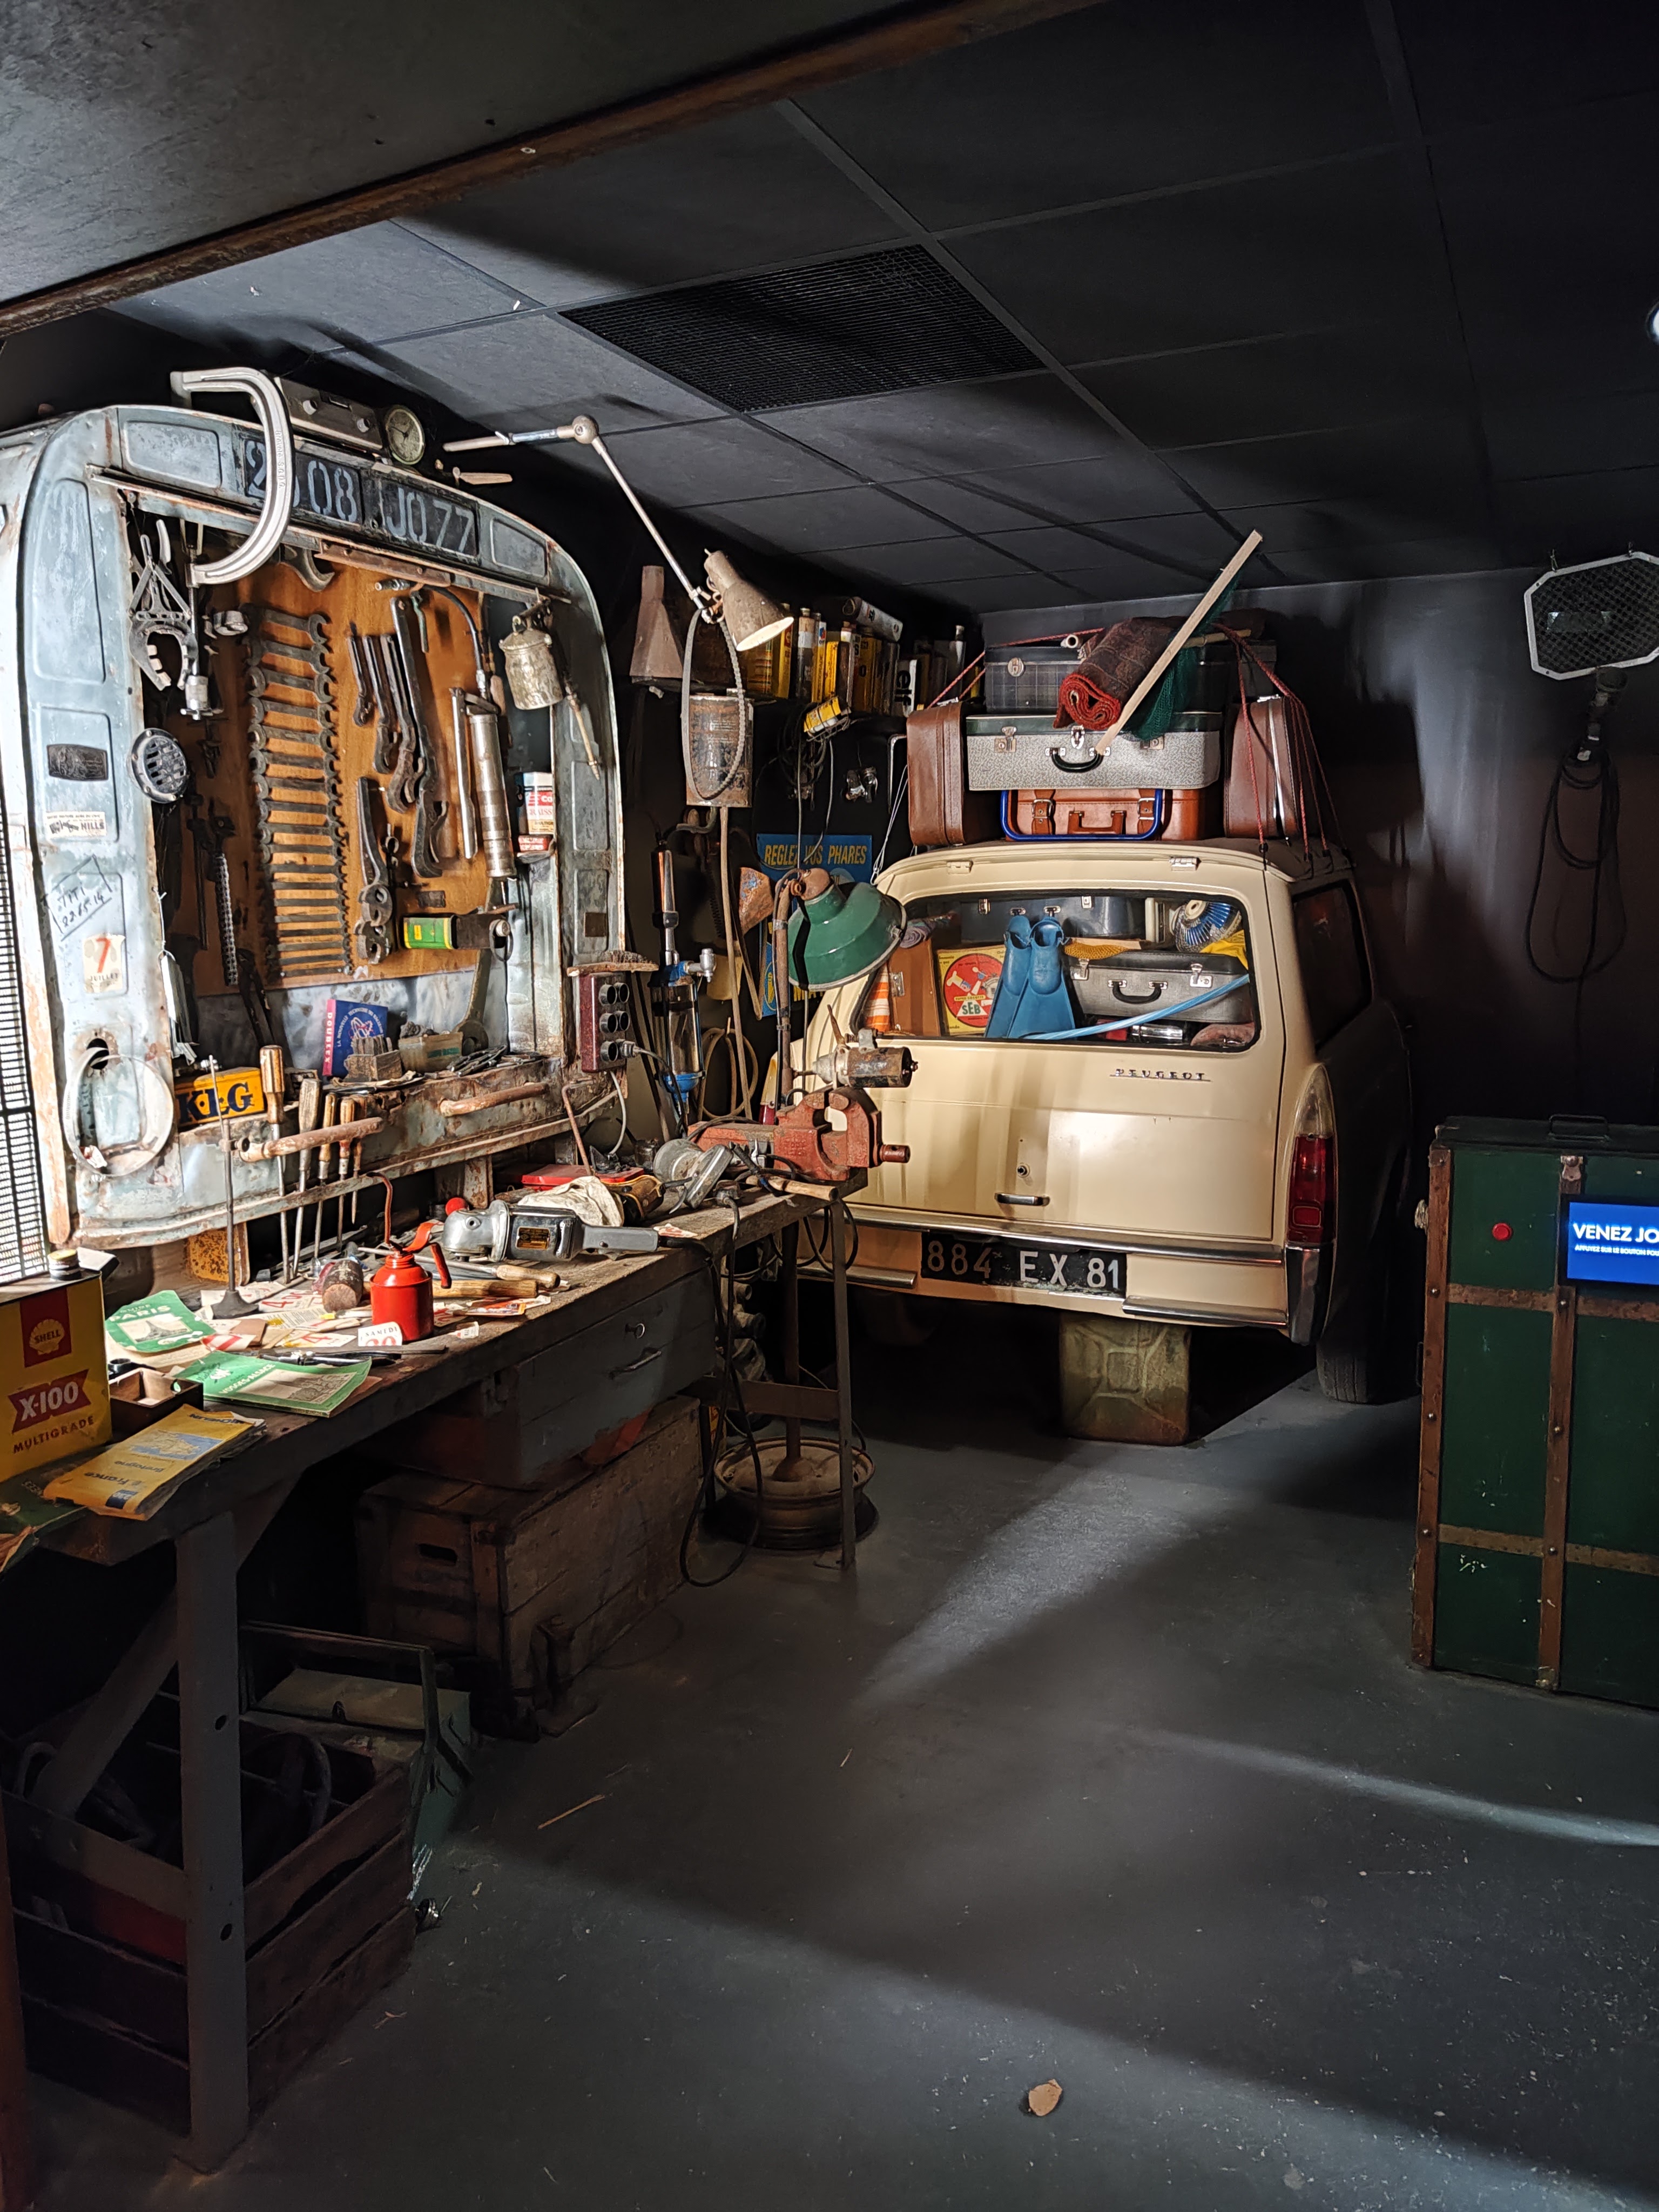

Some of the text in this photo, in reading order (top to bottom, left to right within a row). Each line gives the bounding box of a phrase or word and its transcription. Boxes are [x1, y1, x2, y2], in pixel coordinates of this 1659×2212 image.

[246, 441, 358, 522] 208
[894, 670, 912, 706] elf
[827, 845, 867, 865] PHARES
[96, 938, 111, 973] 7
[90, 973, 119, 982] JUILLET
[962, 1002, 981, 1015] SEB
[325, 1012, 333, 1063] DOUBLEX
[1115, 1069, 1205, 1080] PEUGEOT
[1573, 1223, 1659, 1243] VENEZ JO
[1575, 1244, 1600, 1252] APPUYEZ
[927, 1240, 1119, 1289] 884 EX 81
[109, 1305, 171, 1321] PARIS
[34, 1329, 60, 1344] SHELL
[365, 1327, 397, 1337] SAMEDI
[18, 1381, 79, 1421] X-100
[188, 1413, 245, 1425] MICHELIN
[13, 1415, 95, 1454] MULTIGRADE
[113, 1460, 165, 1473] Bretagne
[84, 1472, 130, 1486] France
